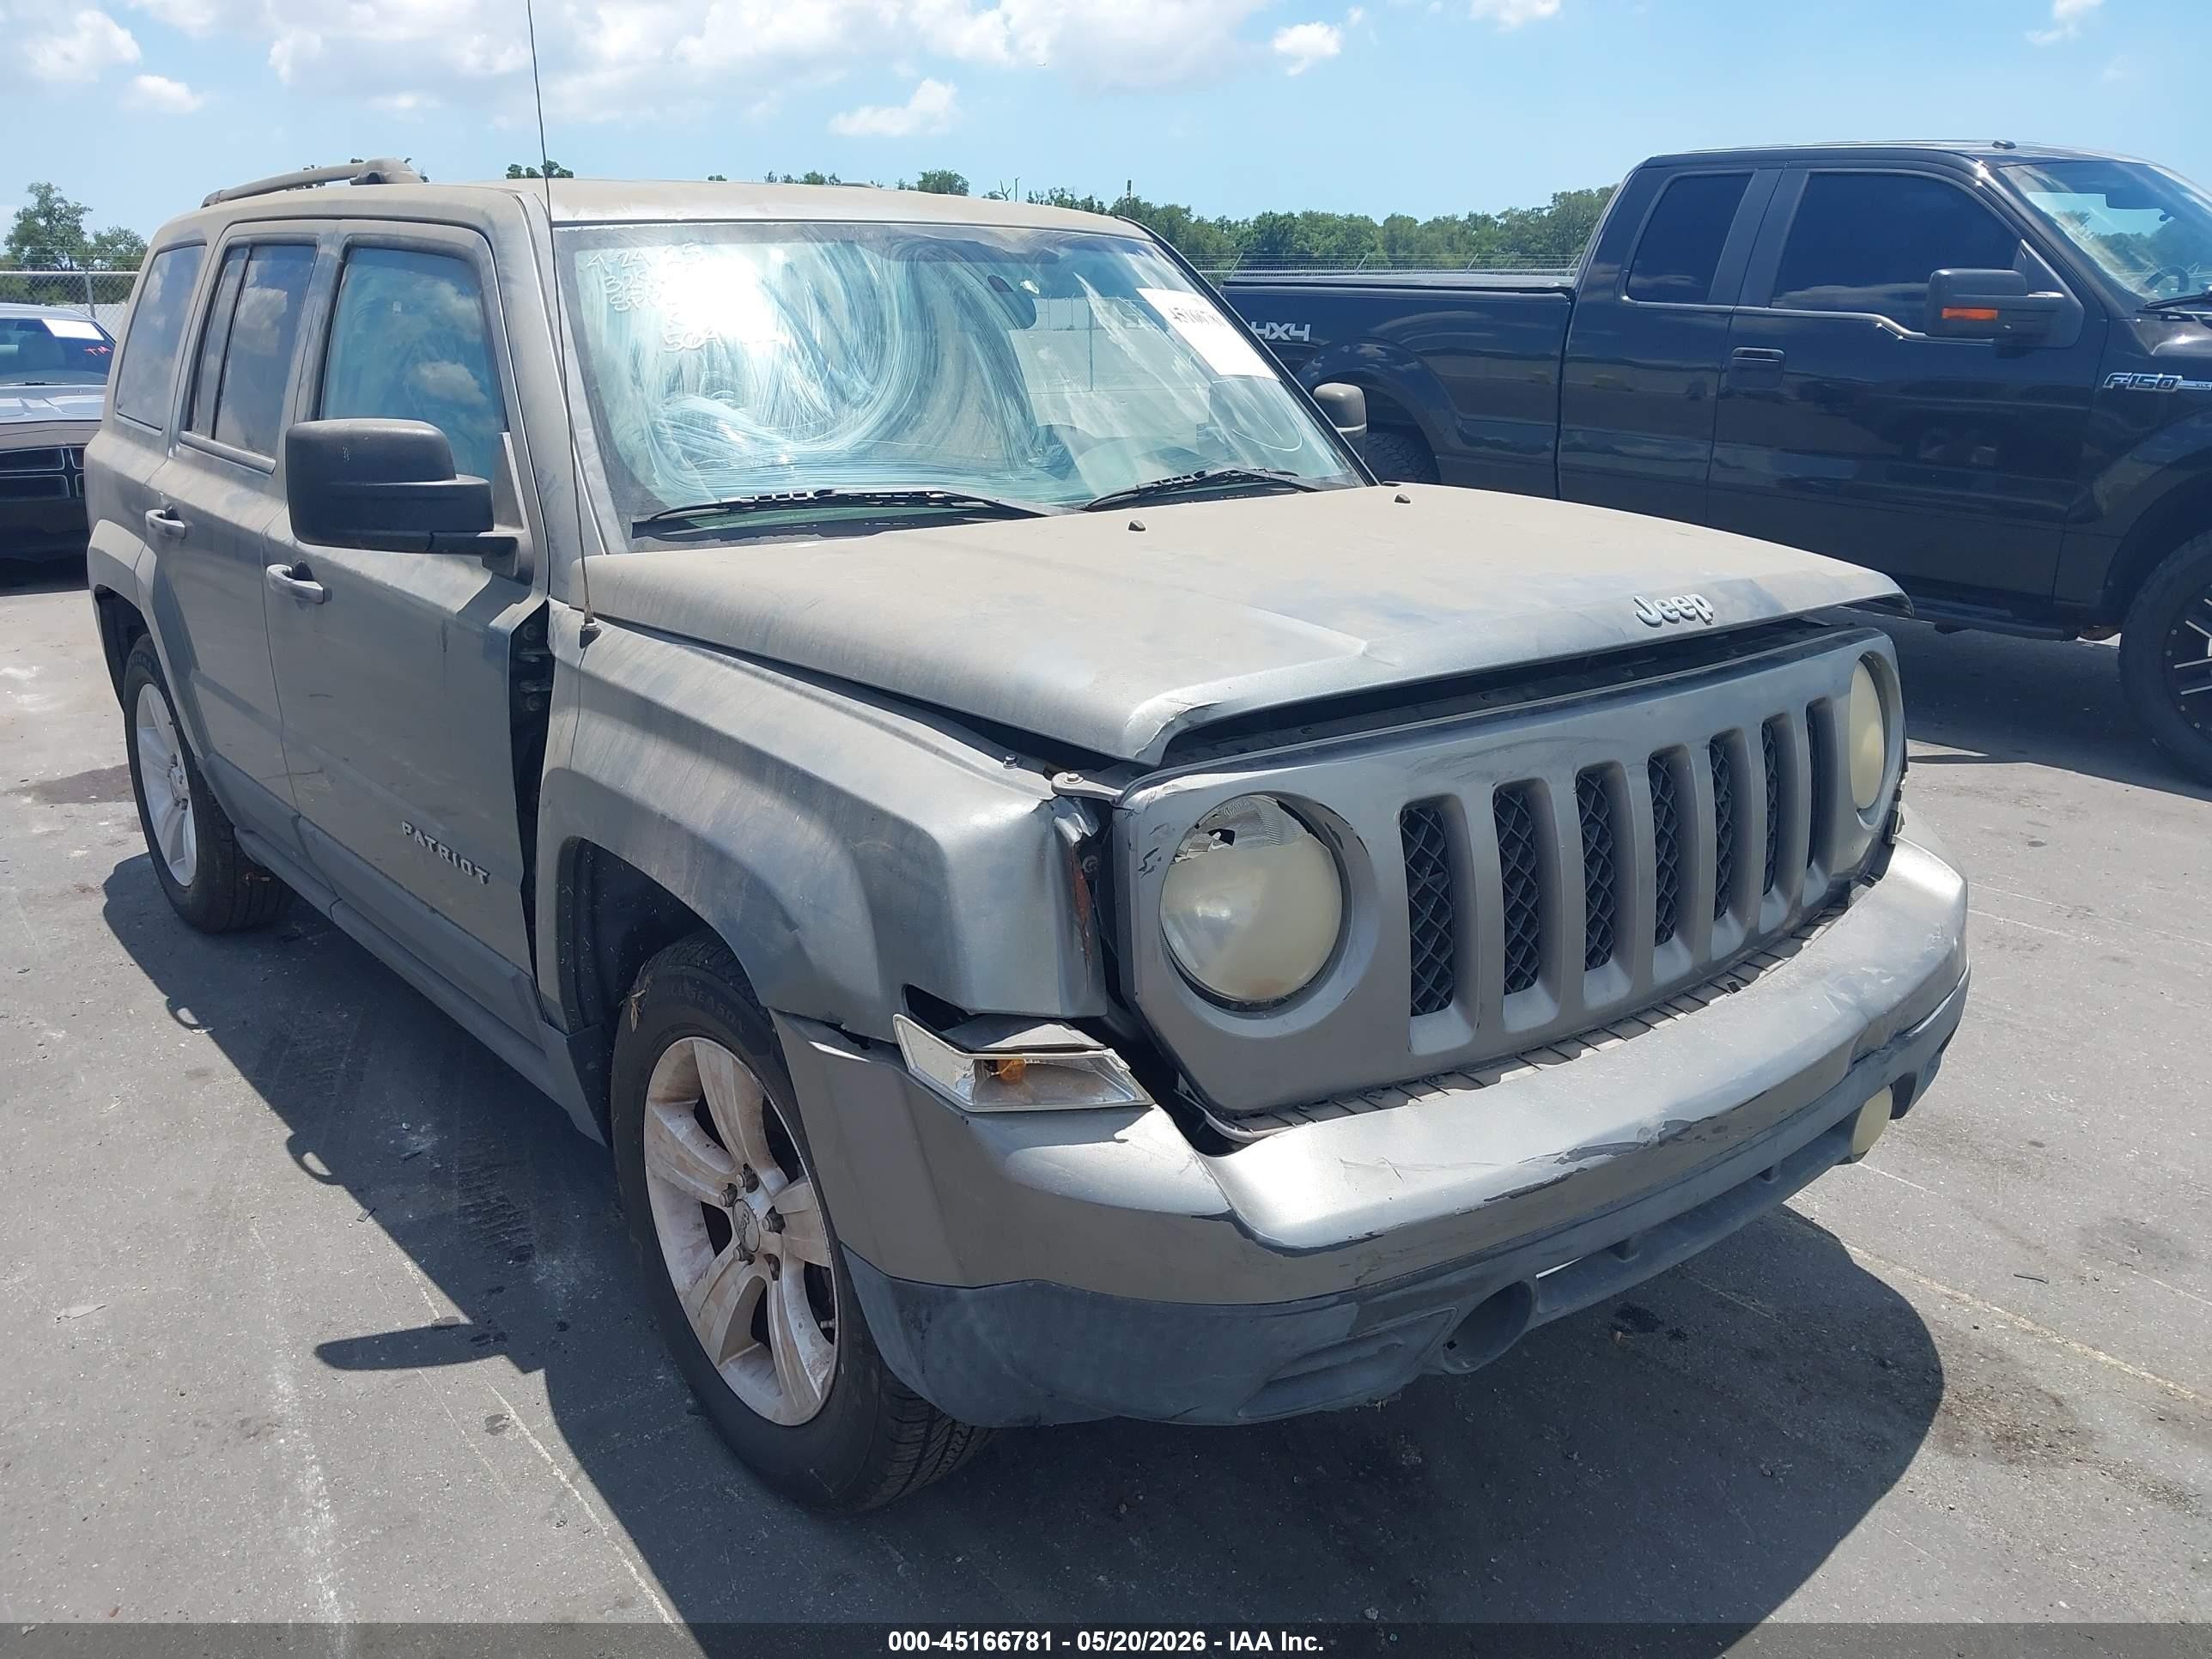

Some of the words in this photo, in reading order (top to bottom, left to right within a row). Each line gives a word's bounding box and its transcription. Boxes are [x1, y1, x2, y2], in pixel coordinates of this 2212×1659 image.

[1251, 321, 1310, 342] 4X4
[2103, 372, 2183, 392] F-150
[1633, 593, 1714, 628] Jeep
[401, 820, 490, 885] PATRIOT
